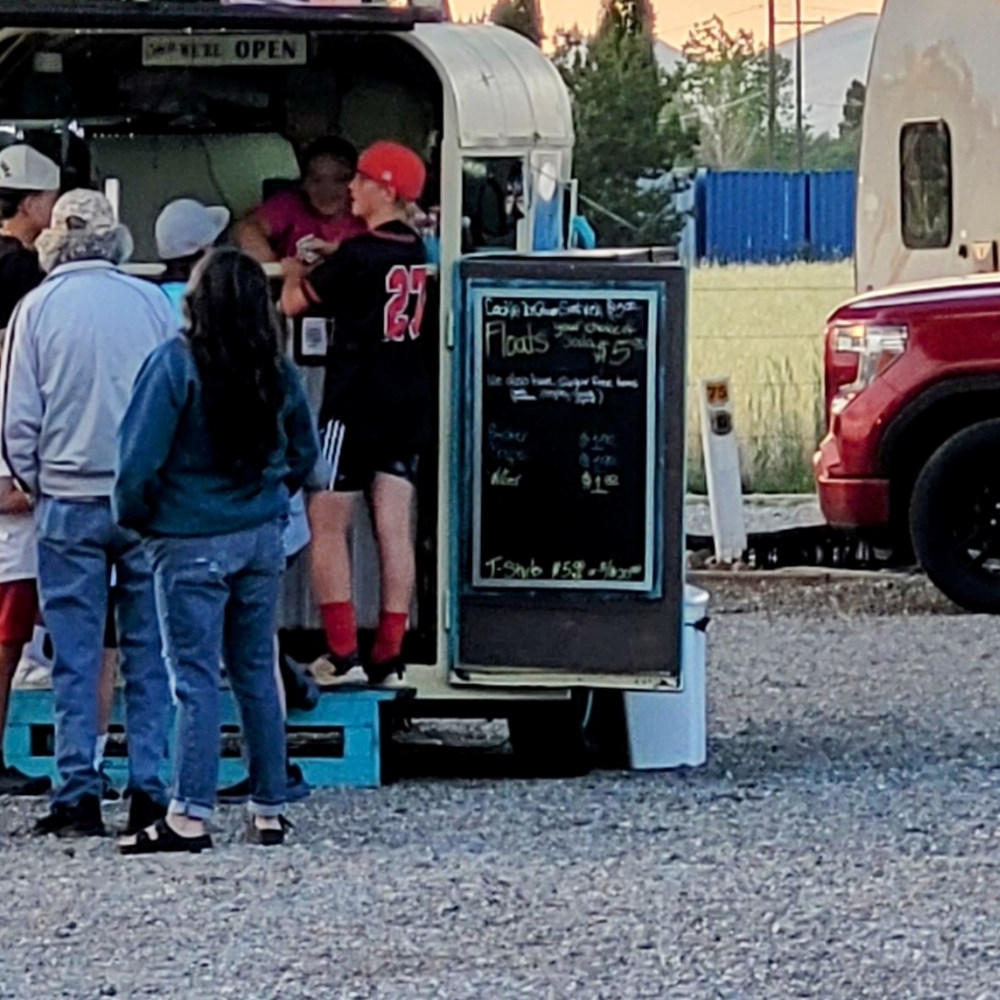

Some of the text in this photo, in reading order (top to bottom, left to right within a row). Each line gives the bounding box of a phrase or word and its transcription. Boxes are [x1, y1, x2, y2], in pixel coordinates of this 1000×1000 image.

[235, 39, 296, 59] OPEN
[383, 264, 427, 342] 27
[485, 320, 550, 358] Floats
